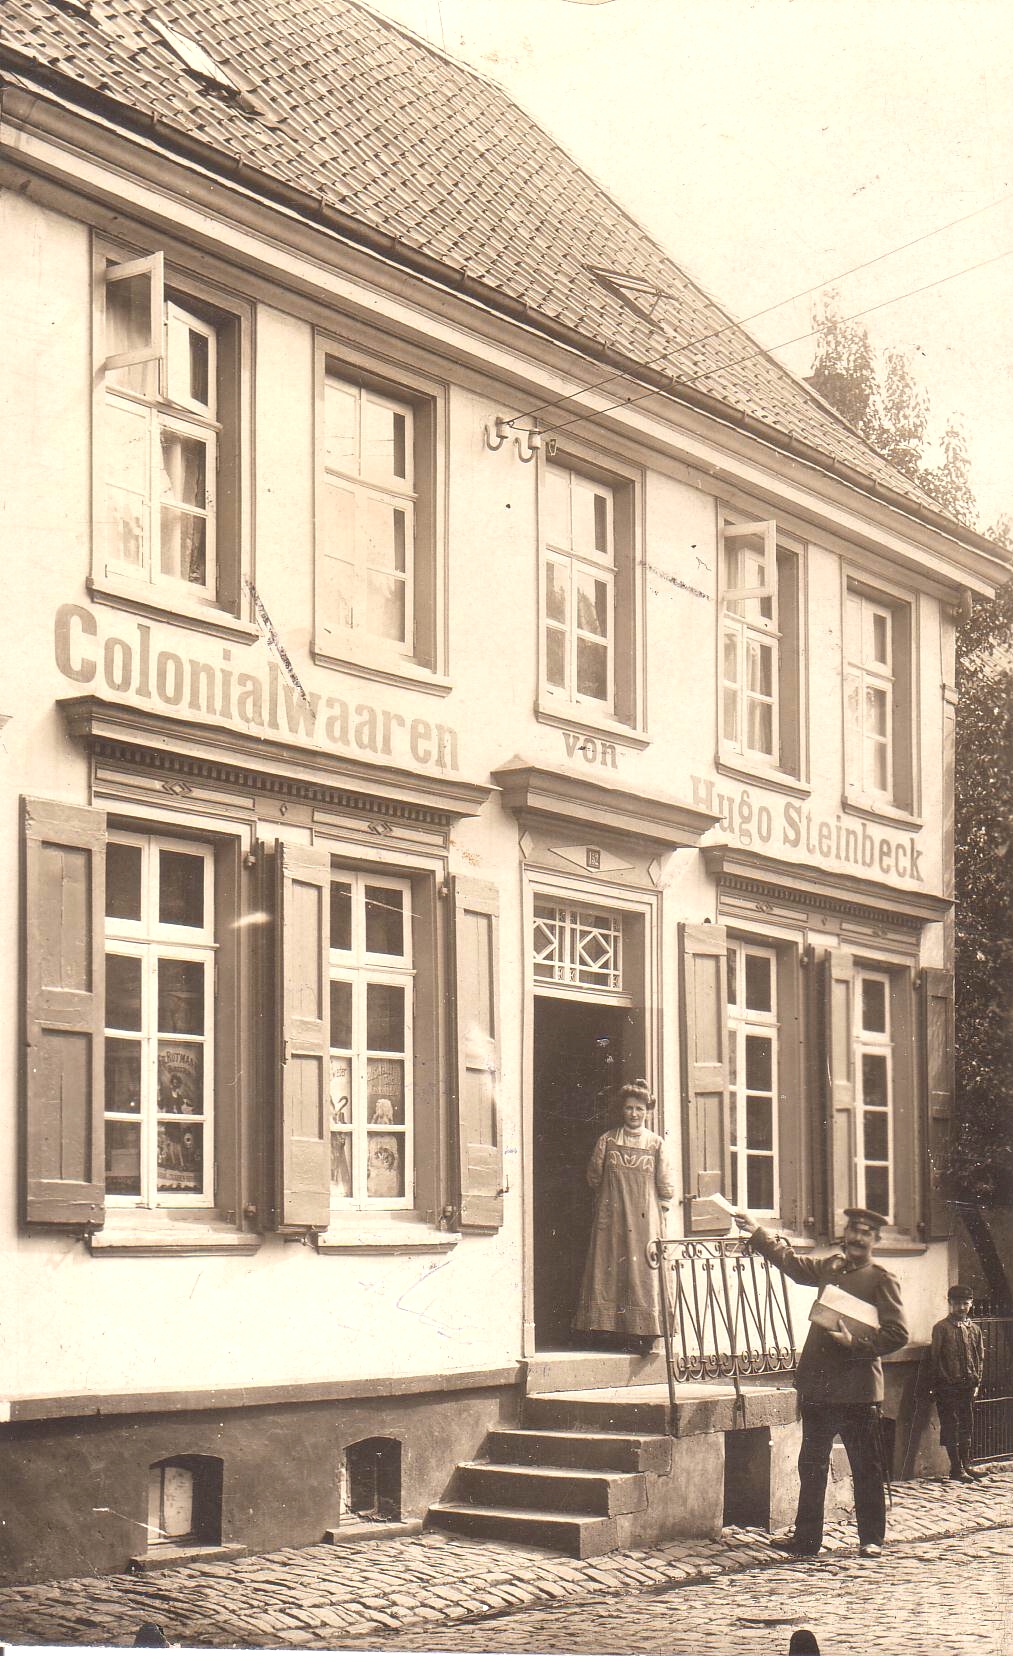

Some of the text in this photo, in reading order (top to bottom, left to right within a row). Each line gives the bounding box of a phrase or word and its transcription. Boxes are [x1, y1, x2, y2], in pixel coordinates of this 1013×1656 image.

[54, 603, 459, 771] Colonialwaaren
[562, 732, 618, 769] von
[690, 775, 924, 882] Hugo Steinbeck
